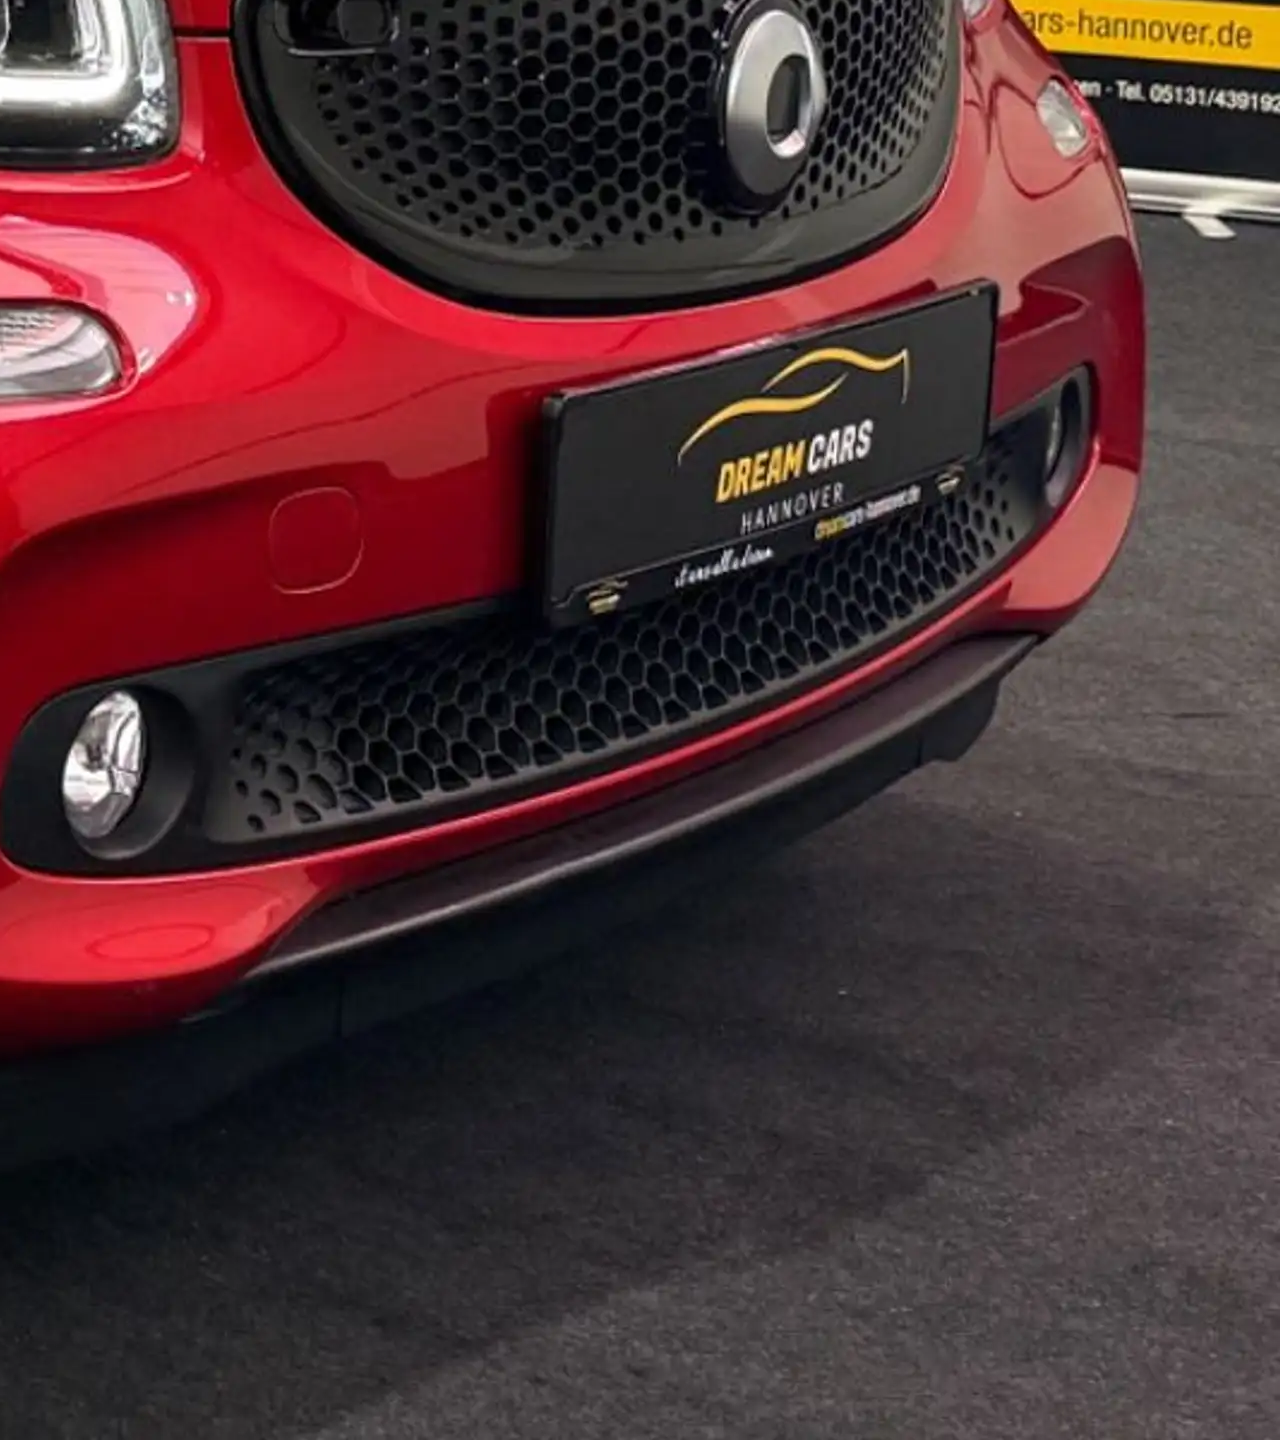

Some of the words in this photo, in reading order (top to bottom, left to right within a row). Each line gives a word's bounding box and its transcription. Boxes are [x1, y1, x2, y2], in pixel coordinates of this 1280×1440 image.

[1022, 9, 1254, 50] ars-hannover.de
[715, 440, 806, 503] DREAM
[806, 419, 874, 475] CARS
[740, 481, 845, 536] HANNOVER
